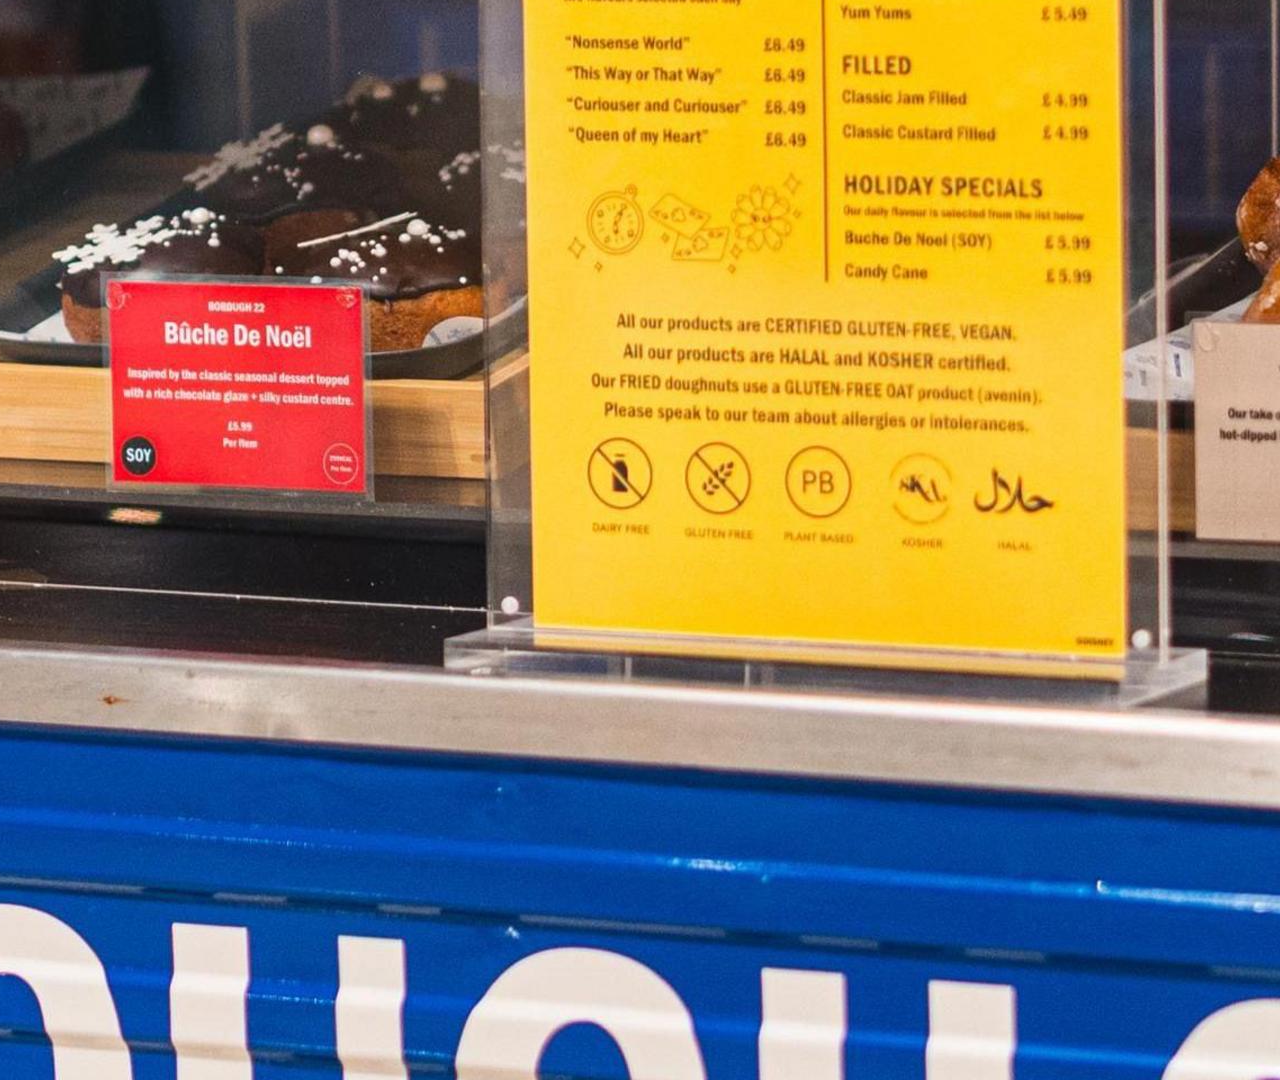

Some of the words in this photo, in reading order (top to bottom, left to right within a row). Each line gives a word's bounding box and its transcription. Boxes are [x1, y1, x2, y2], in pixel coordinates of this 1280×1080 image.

[840, 5, 871, 19] Yum
[874, 5, 912, 19] Yums
[566, 34, 639, 49] "Nonsense
[642, 36, 689, 50] World"
[842, 54, 912, 75] FILLED
[567, 65, 600, 80] "This
[603, 66, 632, 83] Way
[635, 70, 649, 81] or
[653, 66, 683, 81] That
[686, 67, 721, 84] Way"
[567, 96, 640, 111] "Curiouser
[643, 98, 670, 112] and
[672, 98, 747, 113] Curiouser"
[841, 89, 893, 104] Classic
[897, 92, 925, 104] Jam
[928, 90, 968, 105] Filled
[569, 126, 619, 143] "Queen
[622, 127, 637, 142] of
[639, 131, 658, 145] my
[662, 129, 708, 143] Heart"
[842, 123, 893, 139] Classic
[897, 125, 954, 140] Custard
[956, 126, 997, 141] Filled
[843, 174, 933, 196] HOLIDAY
[941, 176, 1043, 198] SPECIALS
[844, 230, 890, 245] Buche
[892, 231, 912, 246] De
[915, 232, 948, 247] Noel
[951, 233, 992, 248] (SOY)
[844, 263, 888, 280] Candy
[891, 264, 928, 279] Cane
[165, 321, 227, 345] Bûche
[234, 323, 259, 346] De
[266, 324, 310, 348] Noël
[616, 313, 636, 328] All
[639, 317, 663, 329] our
[667, 315, 732, 333] products
[736, 320, 761, 332] are
[764, 317, 843, 335] CERTIFIED
[846, 320, 954, 339] GLUTEN-FREE,
[960, 323, 1015, 340] VEGAN.
[623, 343, 643, 359] All
[647, 347, 672, 360] our
[676, 345, 745, 365] products
[749, 350, 774, 363] are
[779, 348, 828, 365] HALAL
[834, 351, 863, 366] and
[867, 351, 934, 369] KOSHER
[938, 353, 1009, 371] certified.
[127, 367, 167, 381] Inspired
[168, 368, 179, 381] by
[181, 369, 197, 380] the
[199, 369, 232, 381] classic
[234, 371, 277, 383] seasonal
[279, 372, 314, 384] dessert
[315, 374, 349, 387] topped
[124, 387, 144, 398] with
[146, 389, 152, 398] a
[154, 388, 172, 399] rich
[174, 388, 221, 401] chocolate
[223, 390, 248, 403] glaze
[259, 391, 280, 404] silky
[282, 393, 318, 404] custard
[320, 394, 354, 405] centre.
[591, 372, 615, 388] Our
[619, 373, 661, 390] FRIED
[664, 375, 739, 395] doughnuts
[742, 381, 768, 394] use
[771, 382, 781, 394] a
[784, 379, 882, 398] GLUTEN-FREE
[885, 383, 914, 399] OAT
[917, 385, 975, 403] product
[977, 388, 1041, 405] (avenin).
[228, 421, 252, 431] £5.99
[603, 401, 653, 418] Please
[657, 404, 701, 423] speak
[705, 406, 720, 421] to
[723, 409, 748, 422] our
[751, 408, 790, 423] team
[793, 409, 838, 425] about
[841, 410, 906, 431] allergies
[910, 416, 926, 428] or
[929, 415, 1028, 432] intolerances.
[126, 447, 151, 462] SOY
[801, 469, 834, 494] PB
